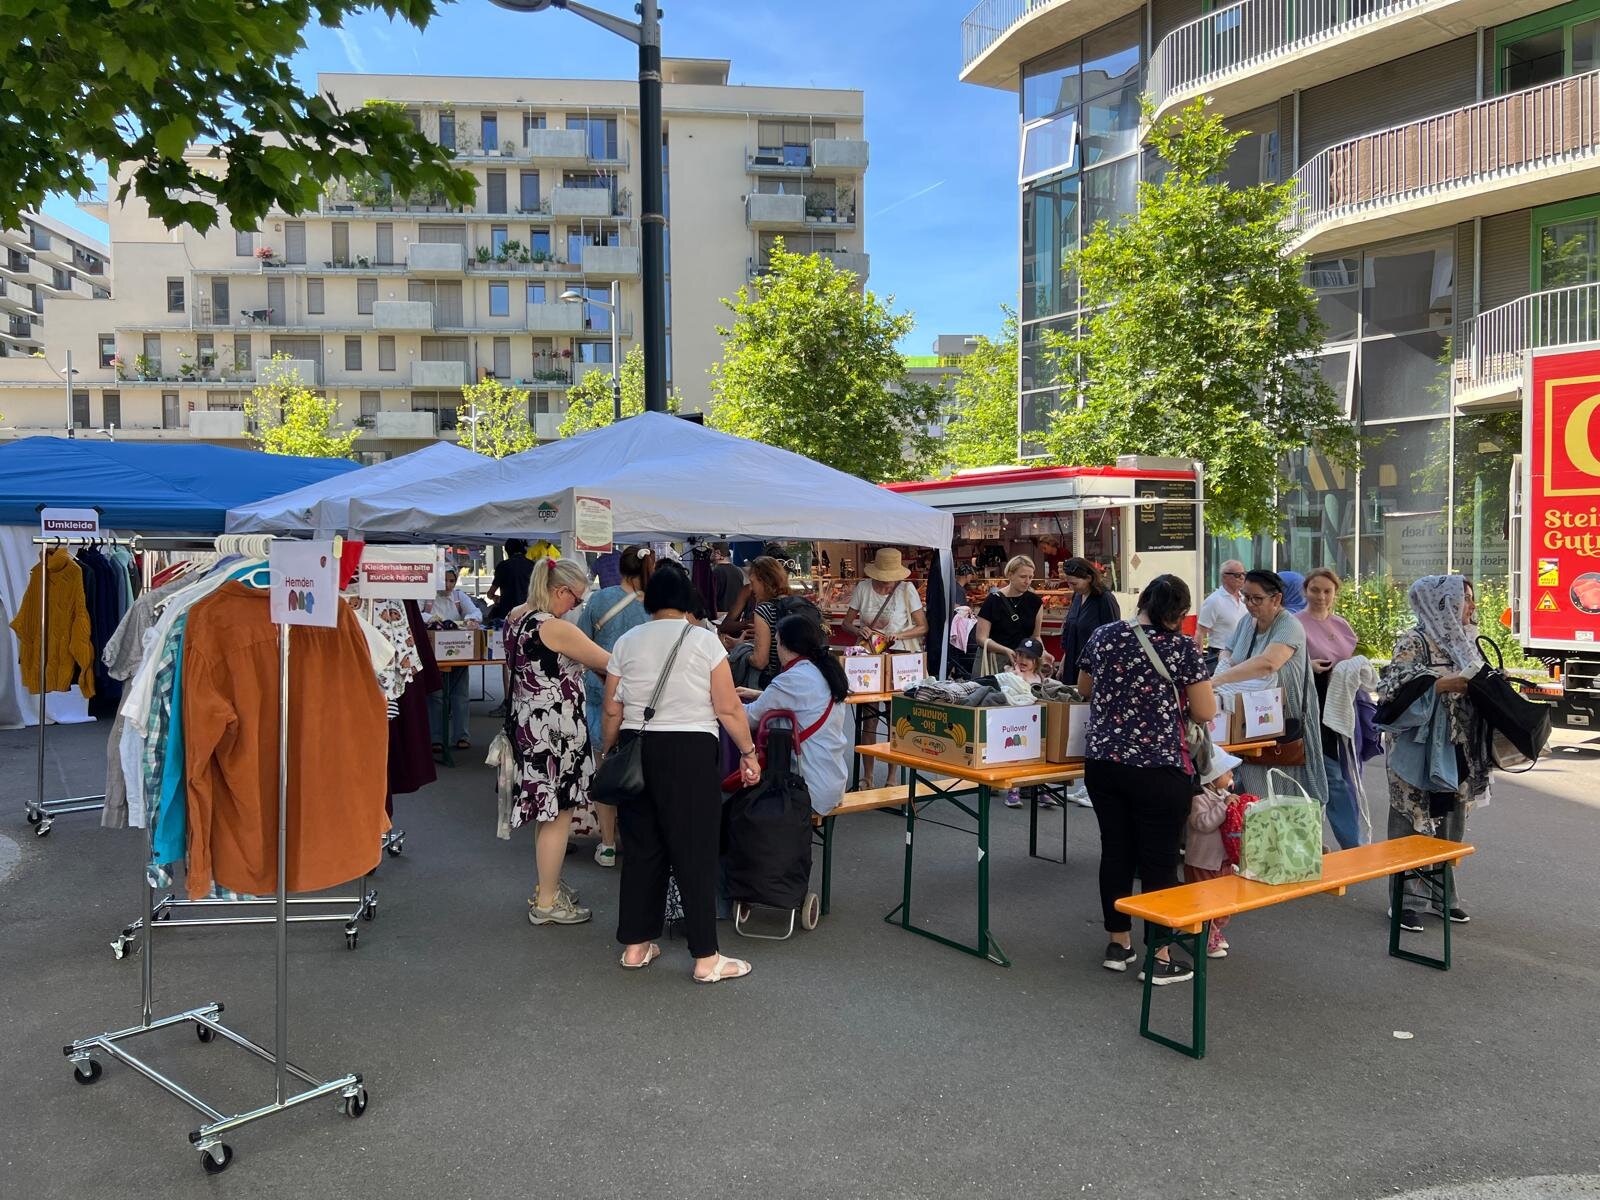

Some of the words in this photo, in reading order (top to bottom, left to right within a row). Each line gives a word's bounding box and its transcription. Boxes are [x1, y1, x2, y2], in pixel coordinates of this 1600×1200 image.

[1544, 506, 1600, 529] Stei
[47, 520, 93, 530] Umkleide
[364, 563, 413, 571] Kleiderhaken
[285, 576, 315, 588] Hemden
[396, 574, 425, 582] hängen.
[912, 706, 948, 724] Bananen
[1002, 724, 1028, 733] Pullover
